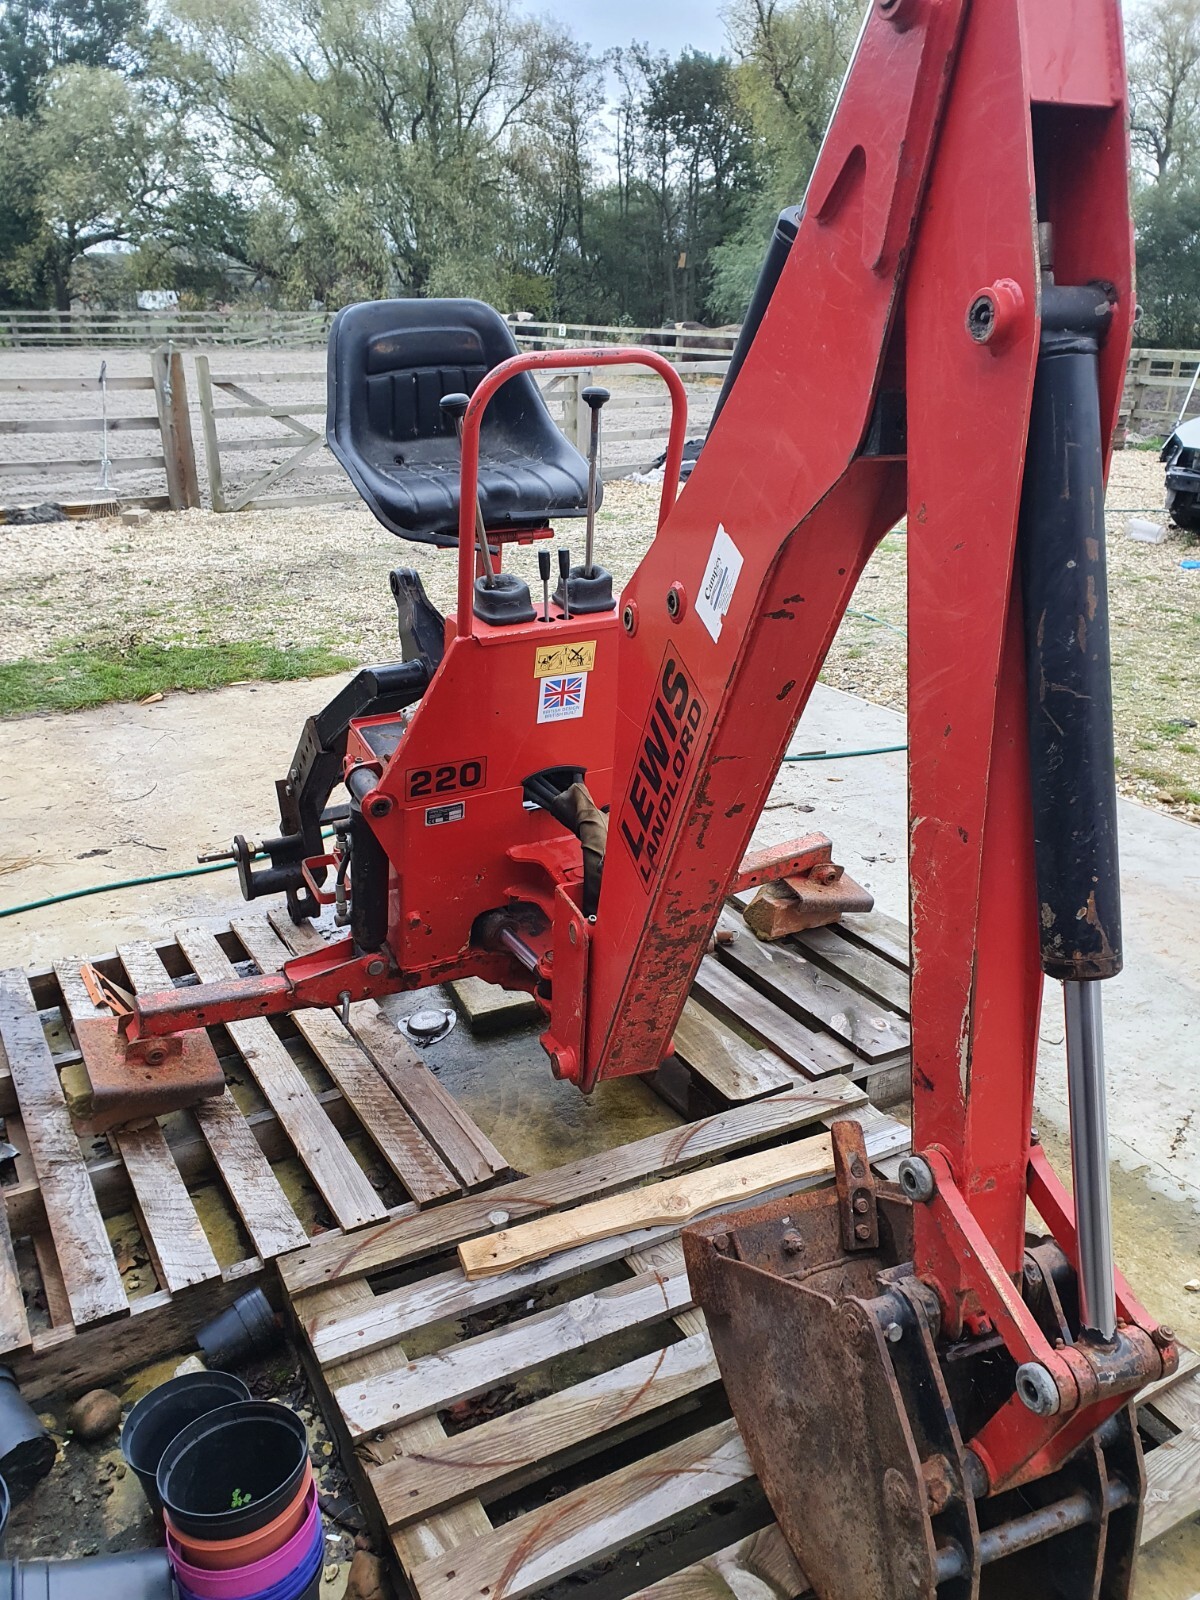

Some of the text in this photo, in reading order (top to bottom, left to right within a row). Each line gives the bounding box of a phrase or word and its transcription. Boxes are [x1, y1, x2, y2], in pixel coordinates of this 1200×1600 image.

[410, 761, 482, 798] 220
[620, 658, 690, 863] LEWIS
[640, 698, 702, 884] LANDLORD
